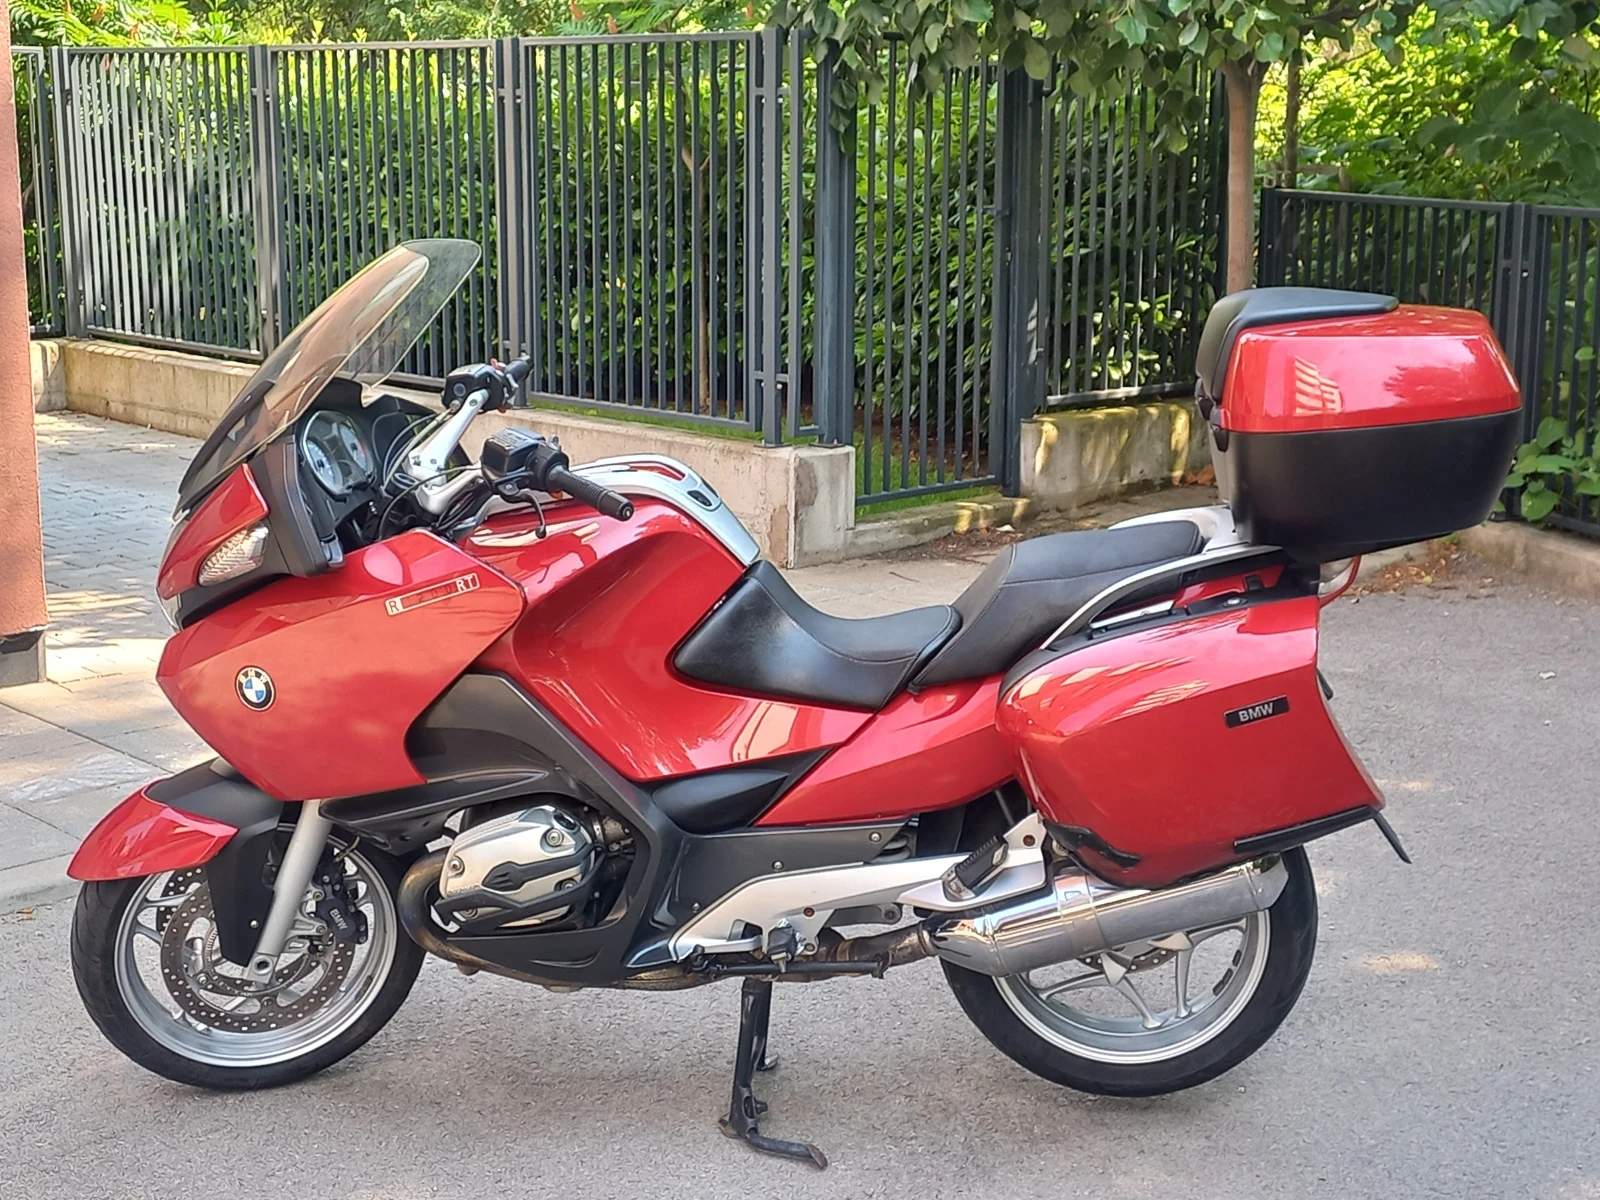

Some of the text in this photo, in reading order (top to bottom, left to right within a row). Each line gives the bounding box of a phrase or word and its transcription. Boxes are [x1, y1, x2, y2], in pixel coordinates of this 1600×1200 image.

[388, 600, 400, 613] R
[456, 575, 475, 592] RT
[1238, 702, 1274, 722] BMW
[330, 908, 348, 930] BMW
